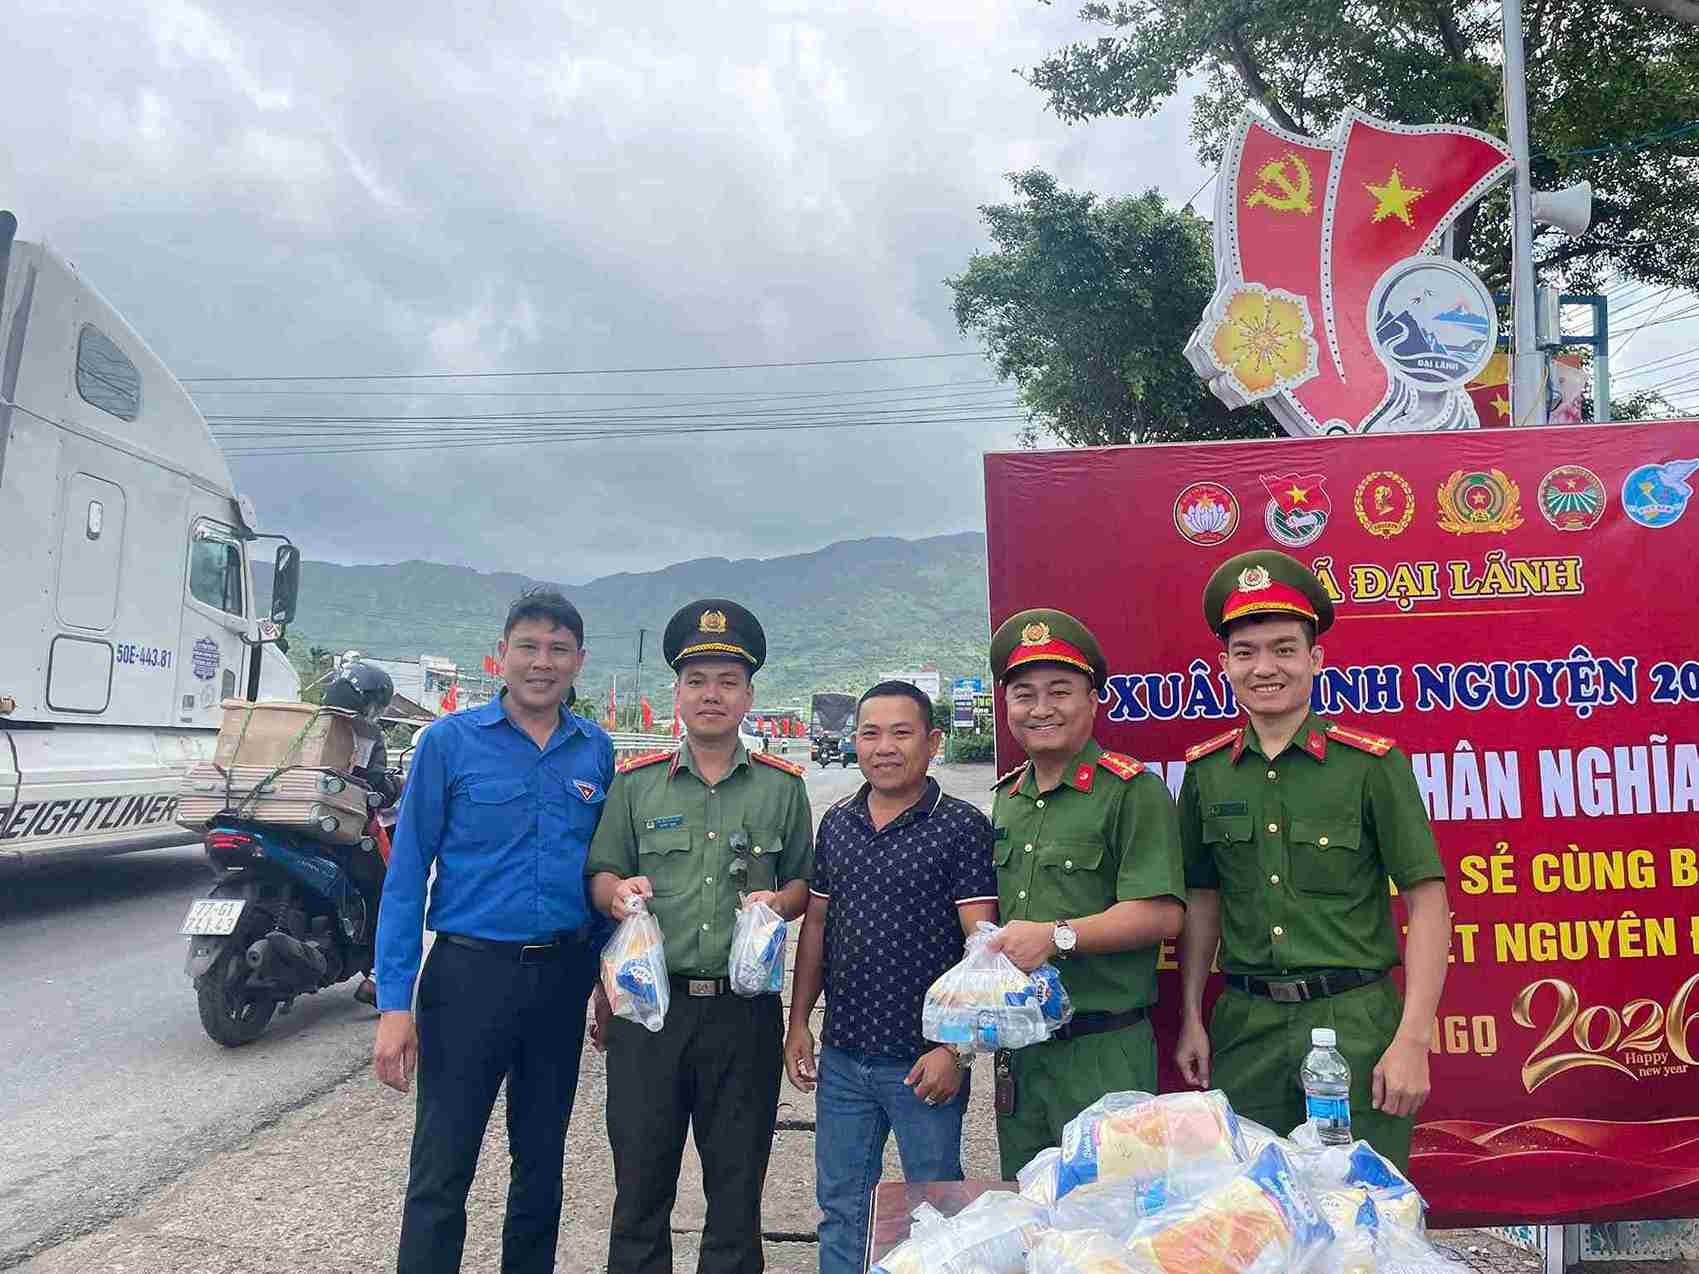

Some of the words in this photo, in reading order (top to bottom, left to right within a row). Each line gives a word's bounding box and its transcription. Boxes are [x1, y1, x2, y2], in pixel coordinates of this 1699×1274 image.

[1314, 557, 1343, 602] Ã
[1351, 563, 1439, 610] ĐẠI
[1449, 550, 1584, 598] LÃNH
[116, 645, 172, 669] 50E-443.81
[1414, 645, 1637, 719] NGUYỆN
[1411, 739, 1522, 822] HÂN
[1459, 842, 1518, 894] SẺ
[1531, 844, 1656, 892] CÙNG
[1494, 910, 1678, 963] NGUYÊN
[1624, 1051, 1669, 1066] Happy
[1639, 1067, 1661, 1077] new
[1663, 1064, 1688, 1077] year
